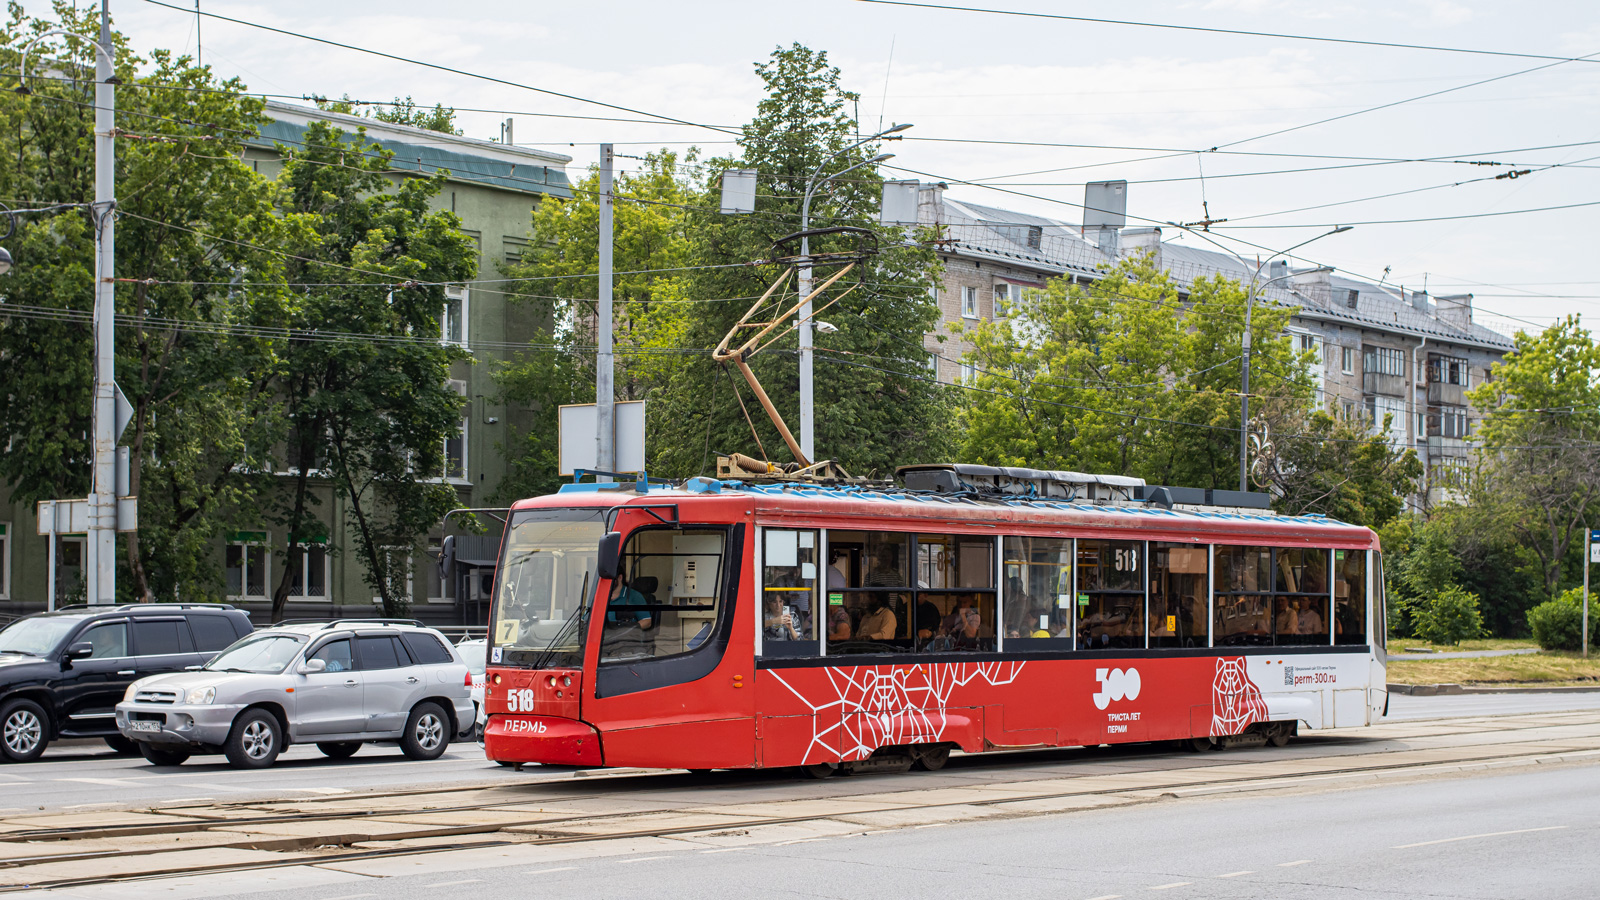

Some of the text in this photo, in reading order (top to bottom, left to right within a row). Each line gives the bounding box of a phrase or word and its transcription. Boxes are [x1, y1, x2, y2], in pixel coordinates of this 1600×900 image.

[1115, 549, 1137, 572] 518
[504, 623, 514, 640] 7
[1295, 673, 1336, 687] perm-300.ru
[507, 688, 534, 712] 518
[1108, 712, 1141, 722] ТРИСТА ЛЕТ
[504, 719, 547, 733] ПЕРМЬ
[1108, 725, 1128, 733] ПЕРМИ
